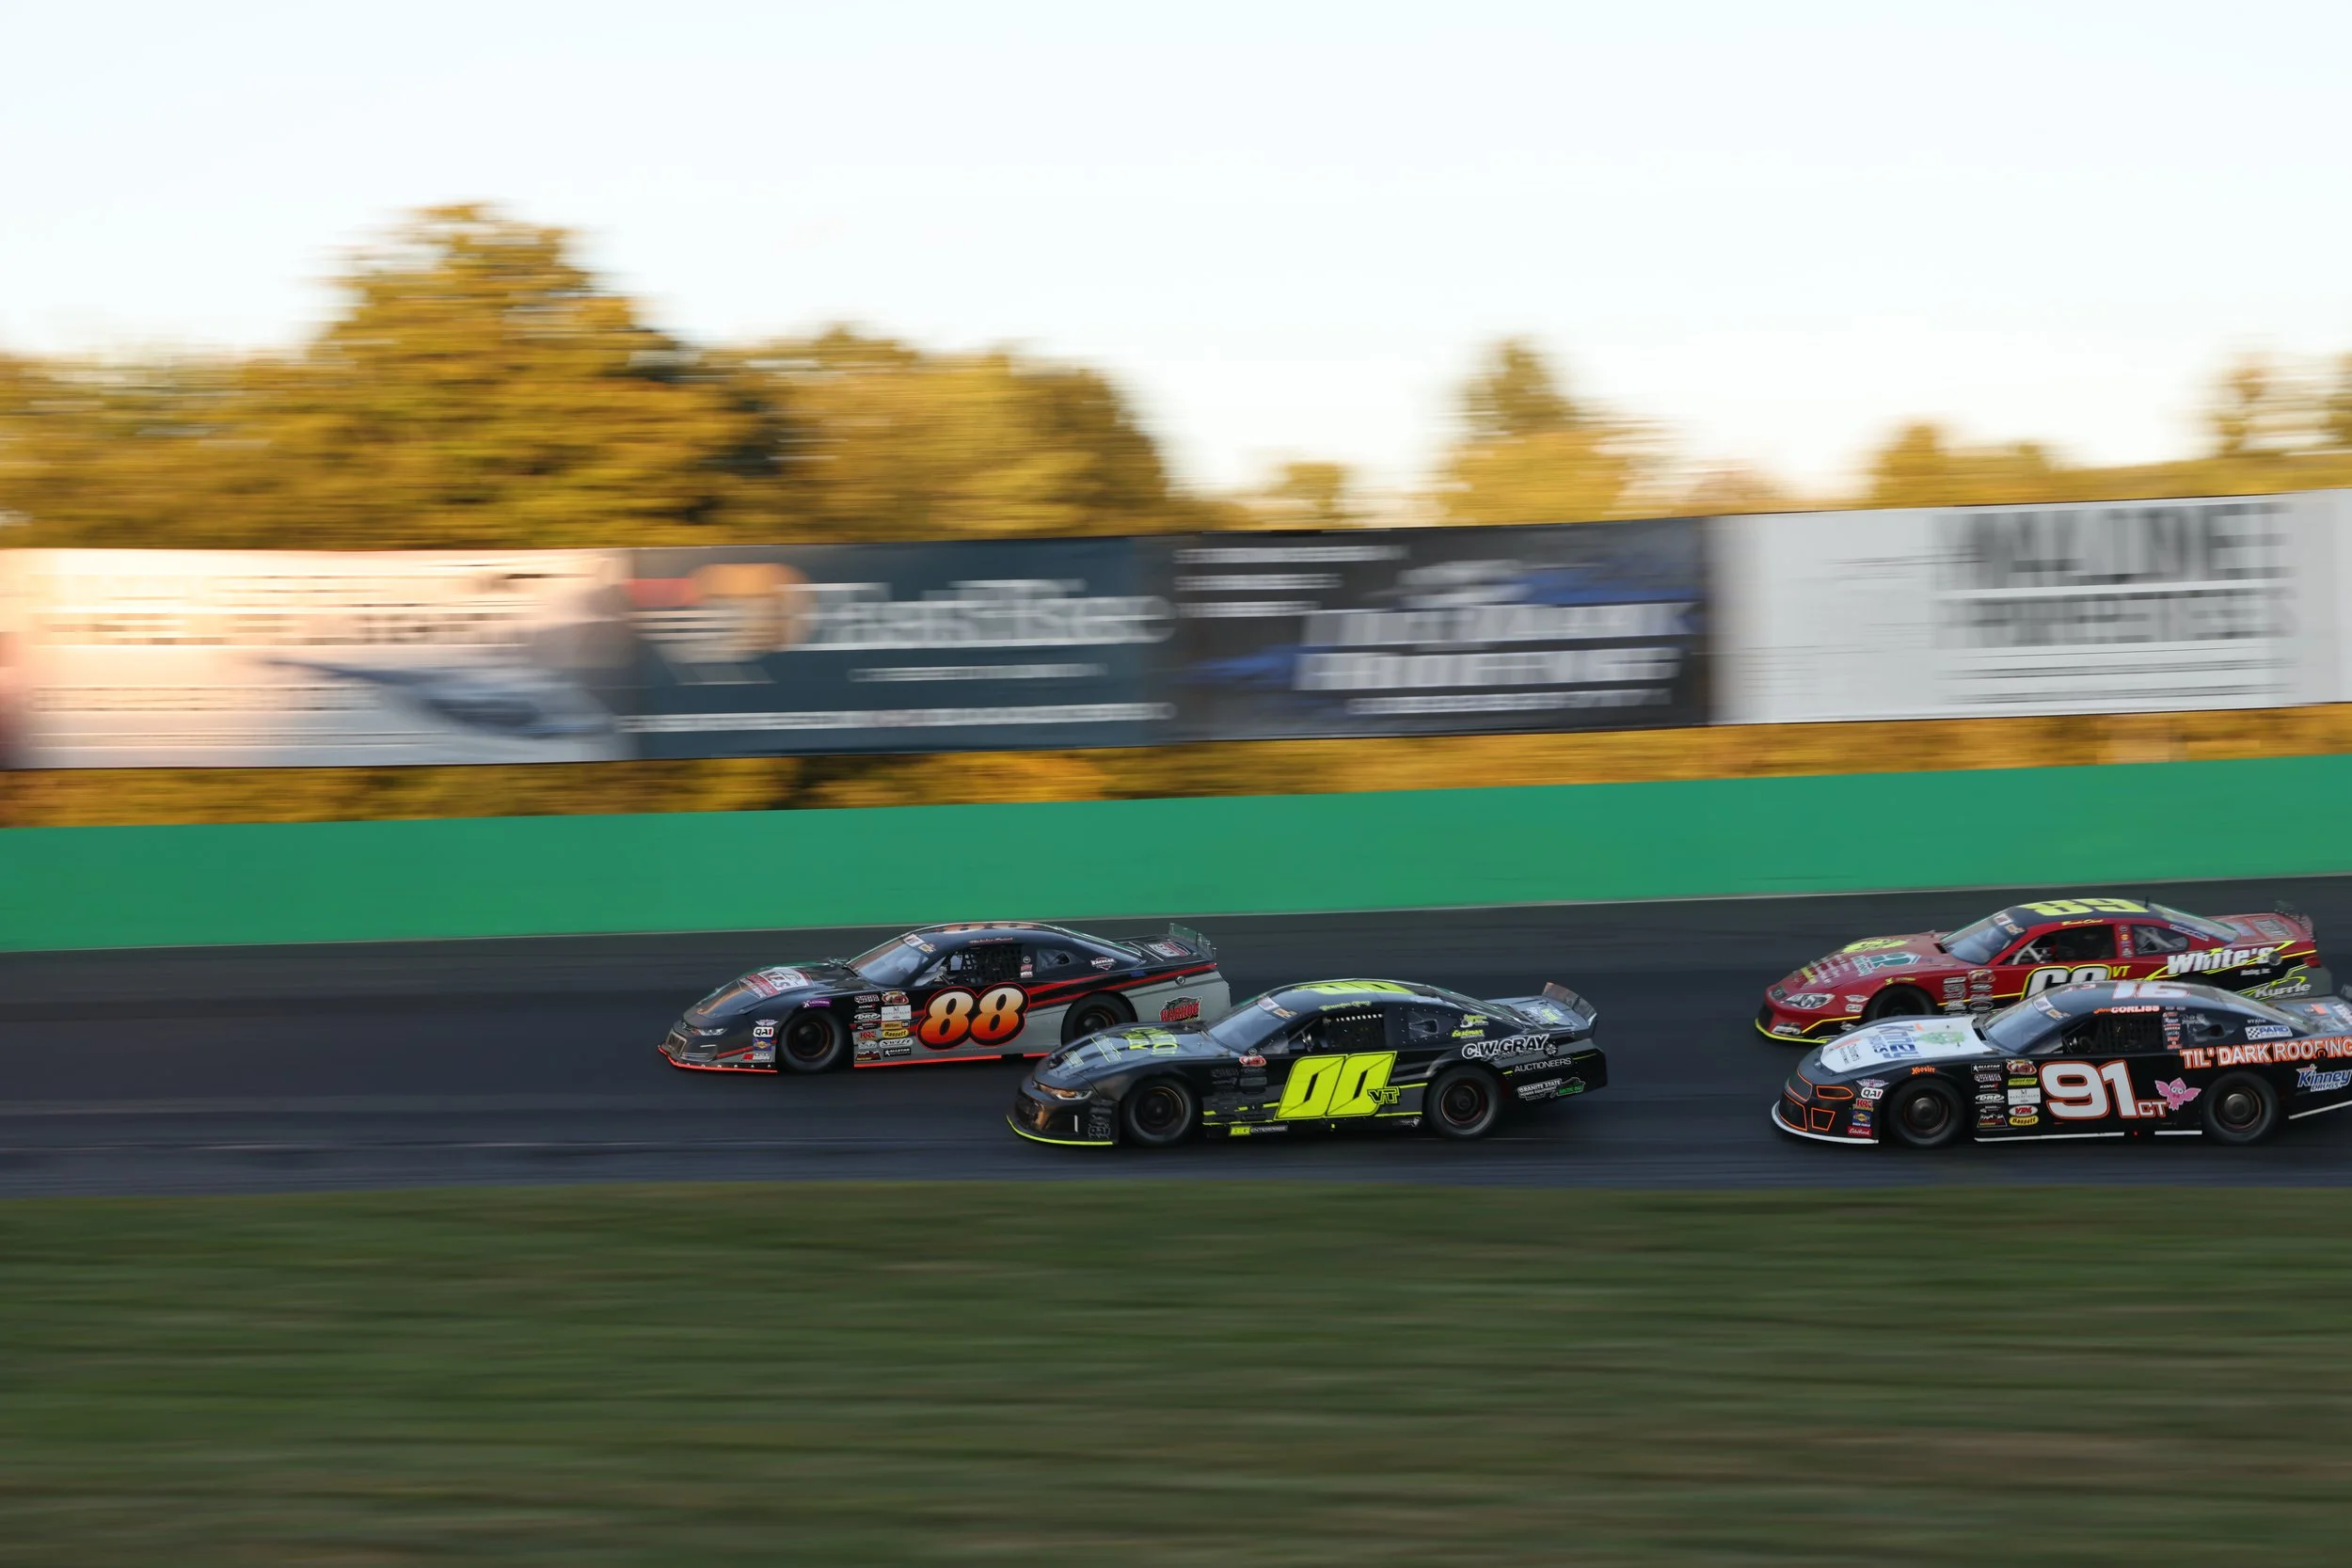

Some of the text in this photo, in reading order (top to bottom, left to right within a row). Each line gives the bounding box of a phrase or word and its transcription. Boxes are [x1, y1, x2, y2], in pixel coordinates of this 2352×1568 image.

[2167, 946, 2275, 975] White's
[2113, 966, 2131, 977] VT
[918, 985, 1027, 1047] 88
[2110, 1006, 2160, 1014] CORLISS
[755, 1028, 773, 1037] QA1
[2180, 1048, 2213, 1069] TIL'
[2217, 1042, 2273, 1067] DARK
[1514, 1058, 1572, 1073] AUCTIONEERS
[1273, 1051, 1397, 1120] 00
[1367, 1086, 1400, 1104] VT
[2297, 1069, 2352, 1088] Kinney
[1863, 1089, 1882, 1098] QA1
[2040, 1059, 2168, 1119] 91 CT
[2311, 1083, 2341, 1092] DRUGS
